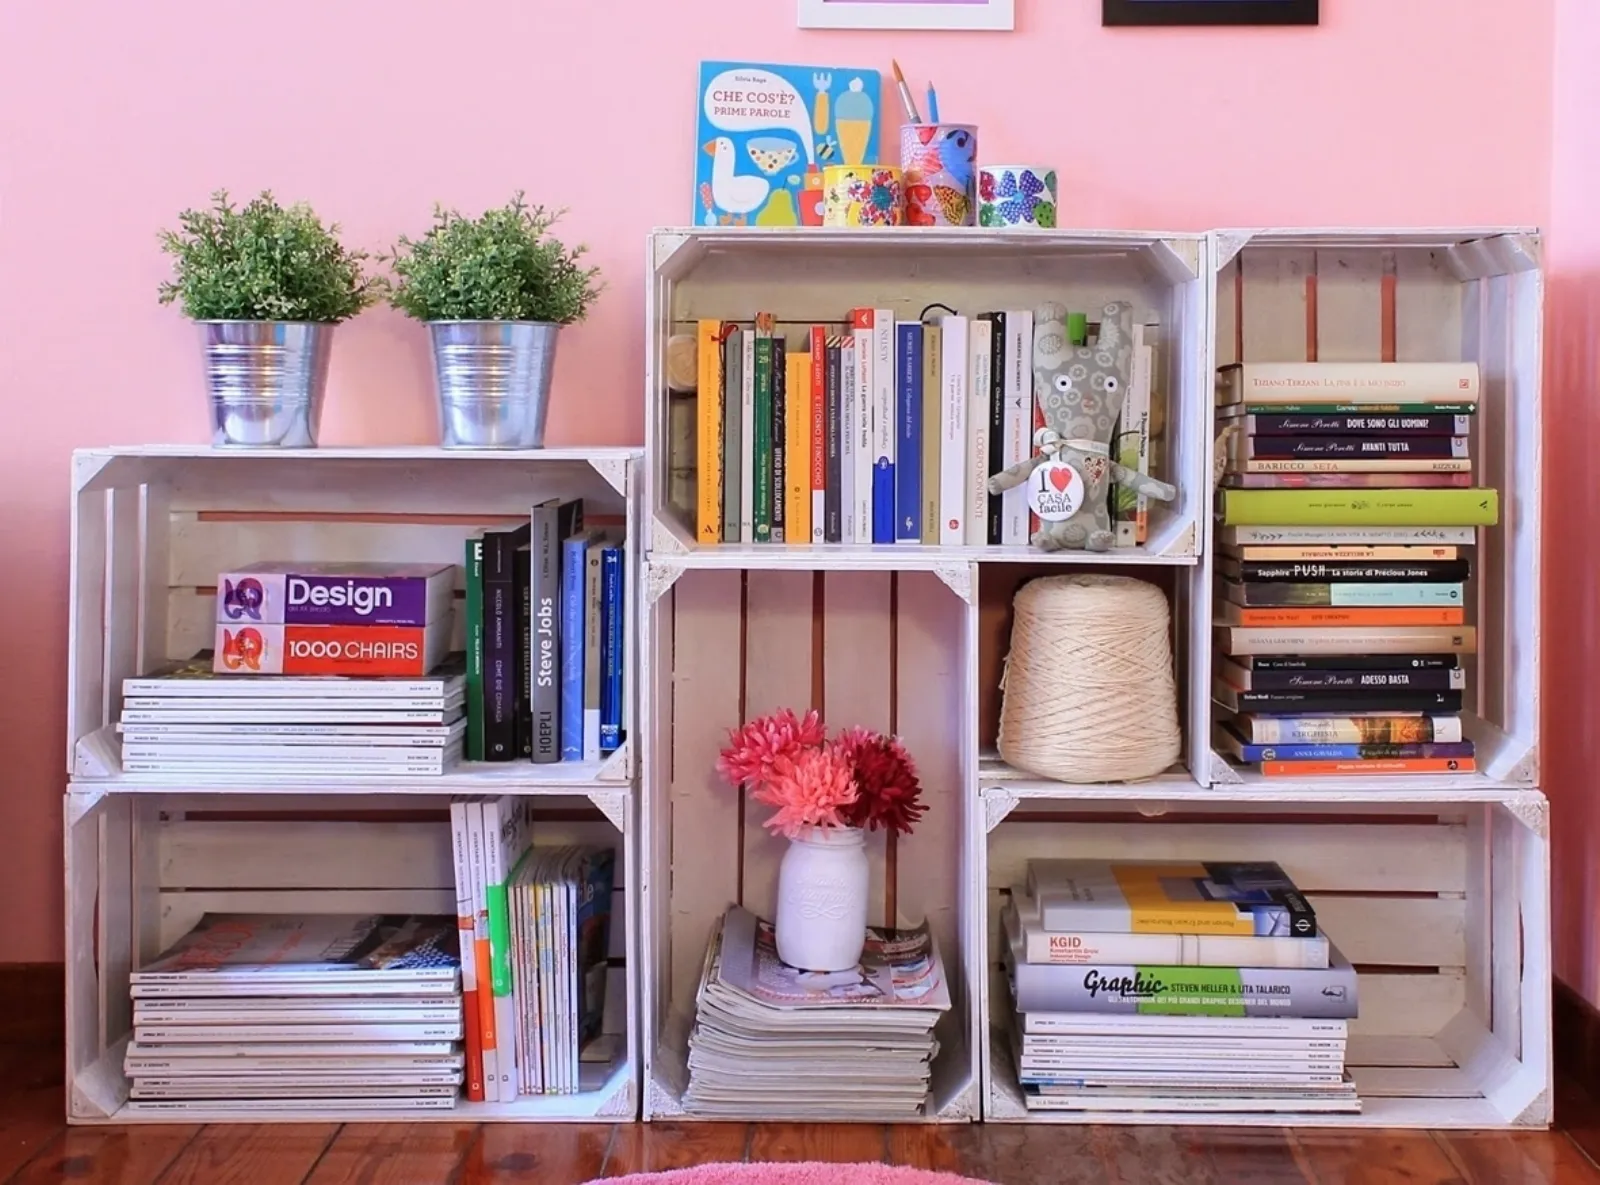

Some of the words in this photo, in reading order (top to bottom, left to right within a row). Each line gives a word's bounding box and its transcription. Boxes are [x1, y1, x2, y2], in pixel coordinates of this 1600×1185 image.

[713, 90, 743, 102] CHE
[746, 90, 795, 105] COS'È?
[714, 106, 747, 116] PRIME
[749, 108, 791, 118] PAROLE
[880, 329, 888, 361] AUSTEN
[1253, 378, 1285, 387] TIZIANO
[1286, 378, 1320, 387] TERZANI
[1347, 418, 1365, 429] DOVE
[1366, 418, 1386, 429] SONO
[1388, 419, 1400, 429] GLI
[1402, 418, 1429, 429] UOMINI?
[976, 437, 984, 468] CORPO
[1361, 442, 1385, 452] AVANTI
[1387, 442, 1409, 452] TUTTA
[1258, 462, 1305, 470] BARICCO
[976, 470, 984, 491] NON
[1038, 468, 1050, 493] I
[1037, 493, 1072, 504] CASA
[1039, 502, 1072, 514] facile
[1258, 569, 1290, 577] Sapphire
[1294, 564, 1326, 577] PUSH
[1374, 568, 1405, 577] Precious
[1407, 569, 1428, 577] Jones
[289, 579, 392, 615] Design
[537, 597, 552, 637] Jobs
[289, 640, 342, 657] 1000
[344, 642, 418, 660] CHAIRS
[538, 640, 552, 687] Steve
[1361, 675, 1386, 685] ADESSO
[1388, 675, 1410, 685] BASTA
[539, 711, 552, 754] HOEPLI
[1212, 920, 1235, 928] Ronan
[1050, 936, 1082, 948] KGID
[1084, 969, 1168, 998] Graphic
[1171, 984, 1199, 993] STEVEN
[1201, 984, 1228, 993] HELLER
[1229, 985, 1236, 993] &
[1238, 985, 1254, 994] LITA
[1255, 985, 1290, 994] TALARICO
